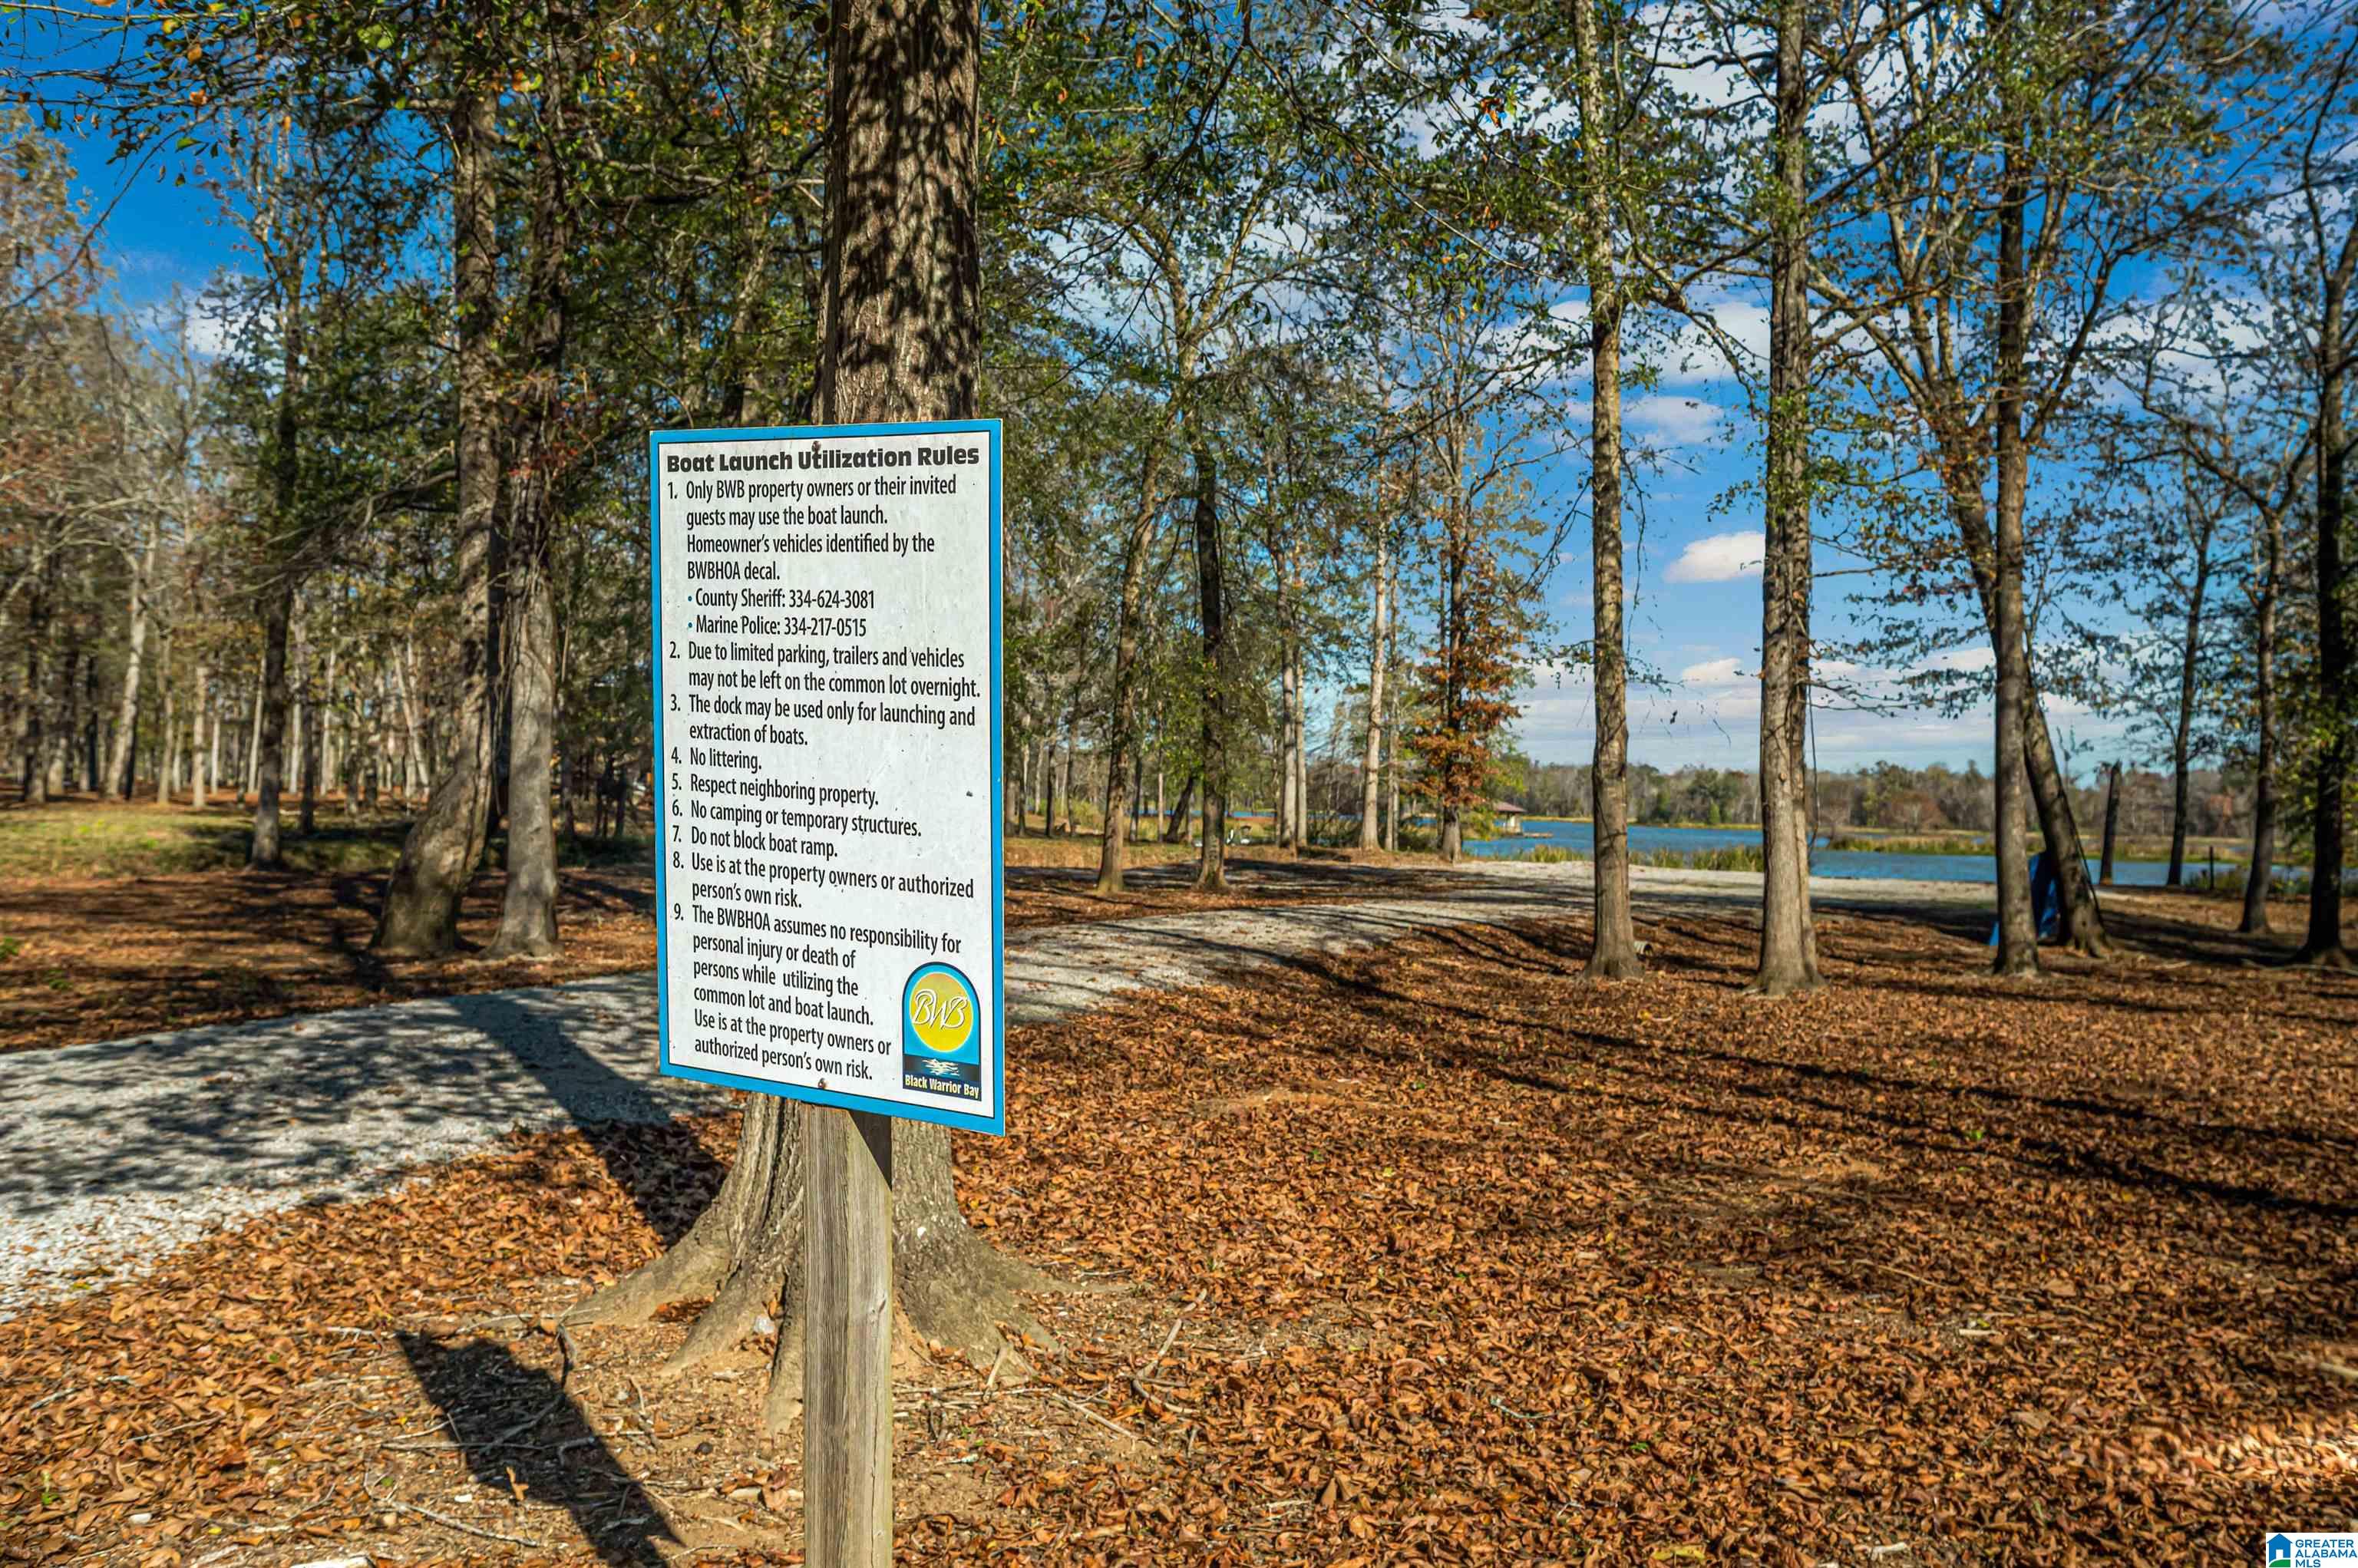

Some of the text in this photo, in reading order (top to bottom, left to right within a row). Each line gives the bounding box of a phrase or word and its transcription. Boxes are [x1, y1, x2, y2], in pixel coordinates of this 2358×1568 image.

[667, 446, 979, 473] Boat Launch Utilization Rules
[668, 474, 956, 503] 1. Only BWB property owners or their invited
[687, 504, 887, 530] guests may use the boat launch.
[688, 532, 934, 557] Homeowner's vehicles identified by the
[688, 561, 780, 580] BWBHOA decal.
[695, 588, 874, 612] County Sheriff: 334-624-3081
[696, 615, 866, 637] Marine Police: 334-217-0515
[669, 641, 964, 668] 2. Due to limited parking, trailers and vehicles
[689, 669, 980, 701] may not be left on the common lot overnight.
[671, 694, 975, 729] 3. The dock may be used only for launching and
[690, 723, 807, 745] extraction of boats.
[671, 747, 761, 774] 4. No littering.
[672, 773, 878, 810] 5. Respect neighboring property.
[672, 799, 921, 837] 6. No camping or temporary structures.
[672, 825, 837, 861] 7. Do not block boat ramp.
[673, 851, 973, 898] 8. Use is at the property owners or authorized
[692, 883, 801, 908] person's own risk.
[674, 903, 961, 956] 9. The BWBHOA assumes no responsibility for
[693, 935, 856, 969] personal injury or death of
[694, 962, 858, 997] persons while utilizing the
[694, 988, 874, 1025] common lot and boat launch.
[911, 989, 968, 1030] BWB
[695, 1008, 891, 1055] Use is at the property owners or
[695, 1037, 872, 1080] authorized person's own risk.
[905, 1074, 979, 1099] Black Warrior Bay
